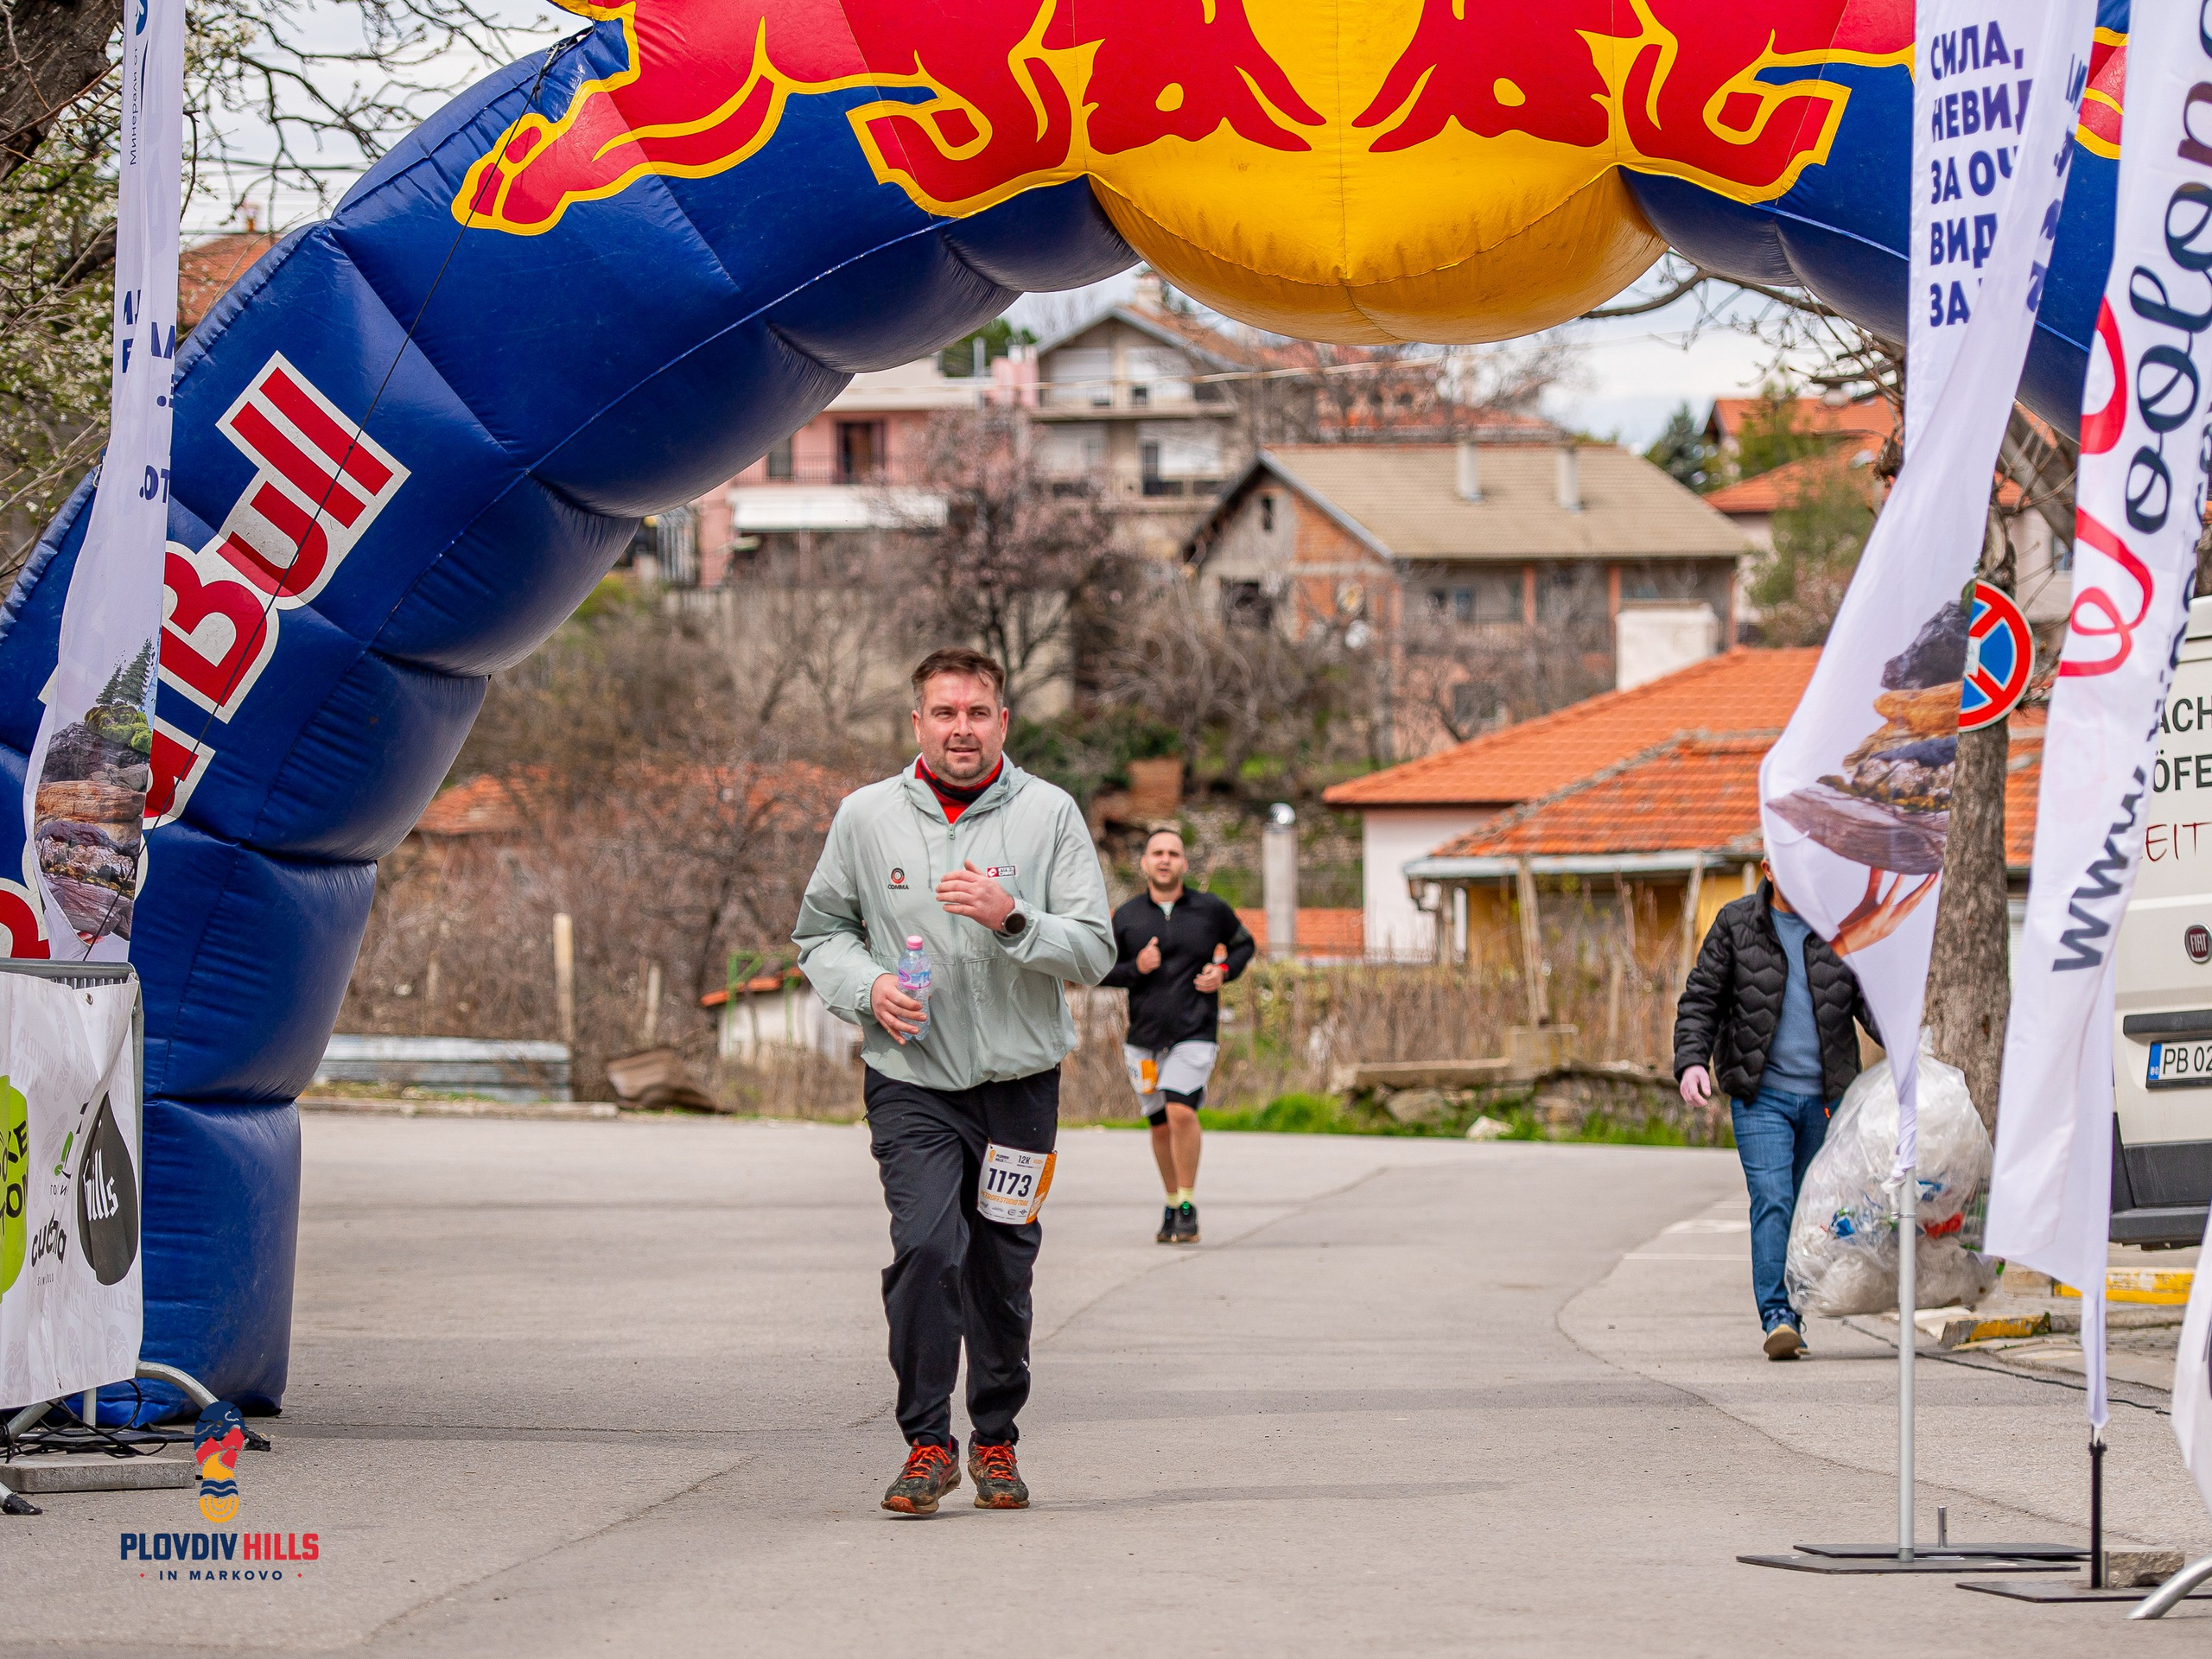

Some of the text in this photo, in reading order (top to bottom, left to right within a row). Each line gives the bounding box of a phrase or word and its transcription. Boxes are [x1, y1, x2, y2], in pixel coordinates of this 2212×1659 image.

[1930, 20, 2024, 80] СИЛА,
[130, 72, 139, 165] Минерали
[1930, 156, 1963, 205] ЗА
[1930, 280, 1971, 327] ЗА
[2190, 933, 2208, 953] FIAT
[2163, 1048, 2189, 1075] PB
[1018, 1155, 1031, 1165] 12K
[987, 1168, 1033, 1198] 1173
